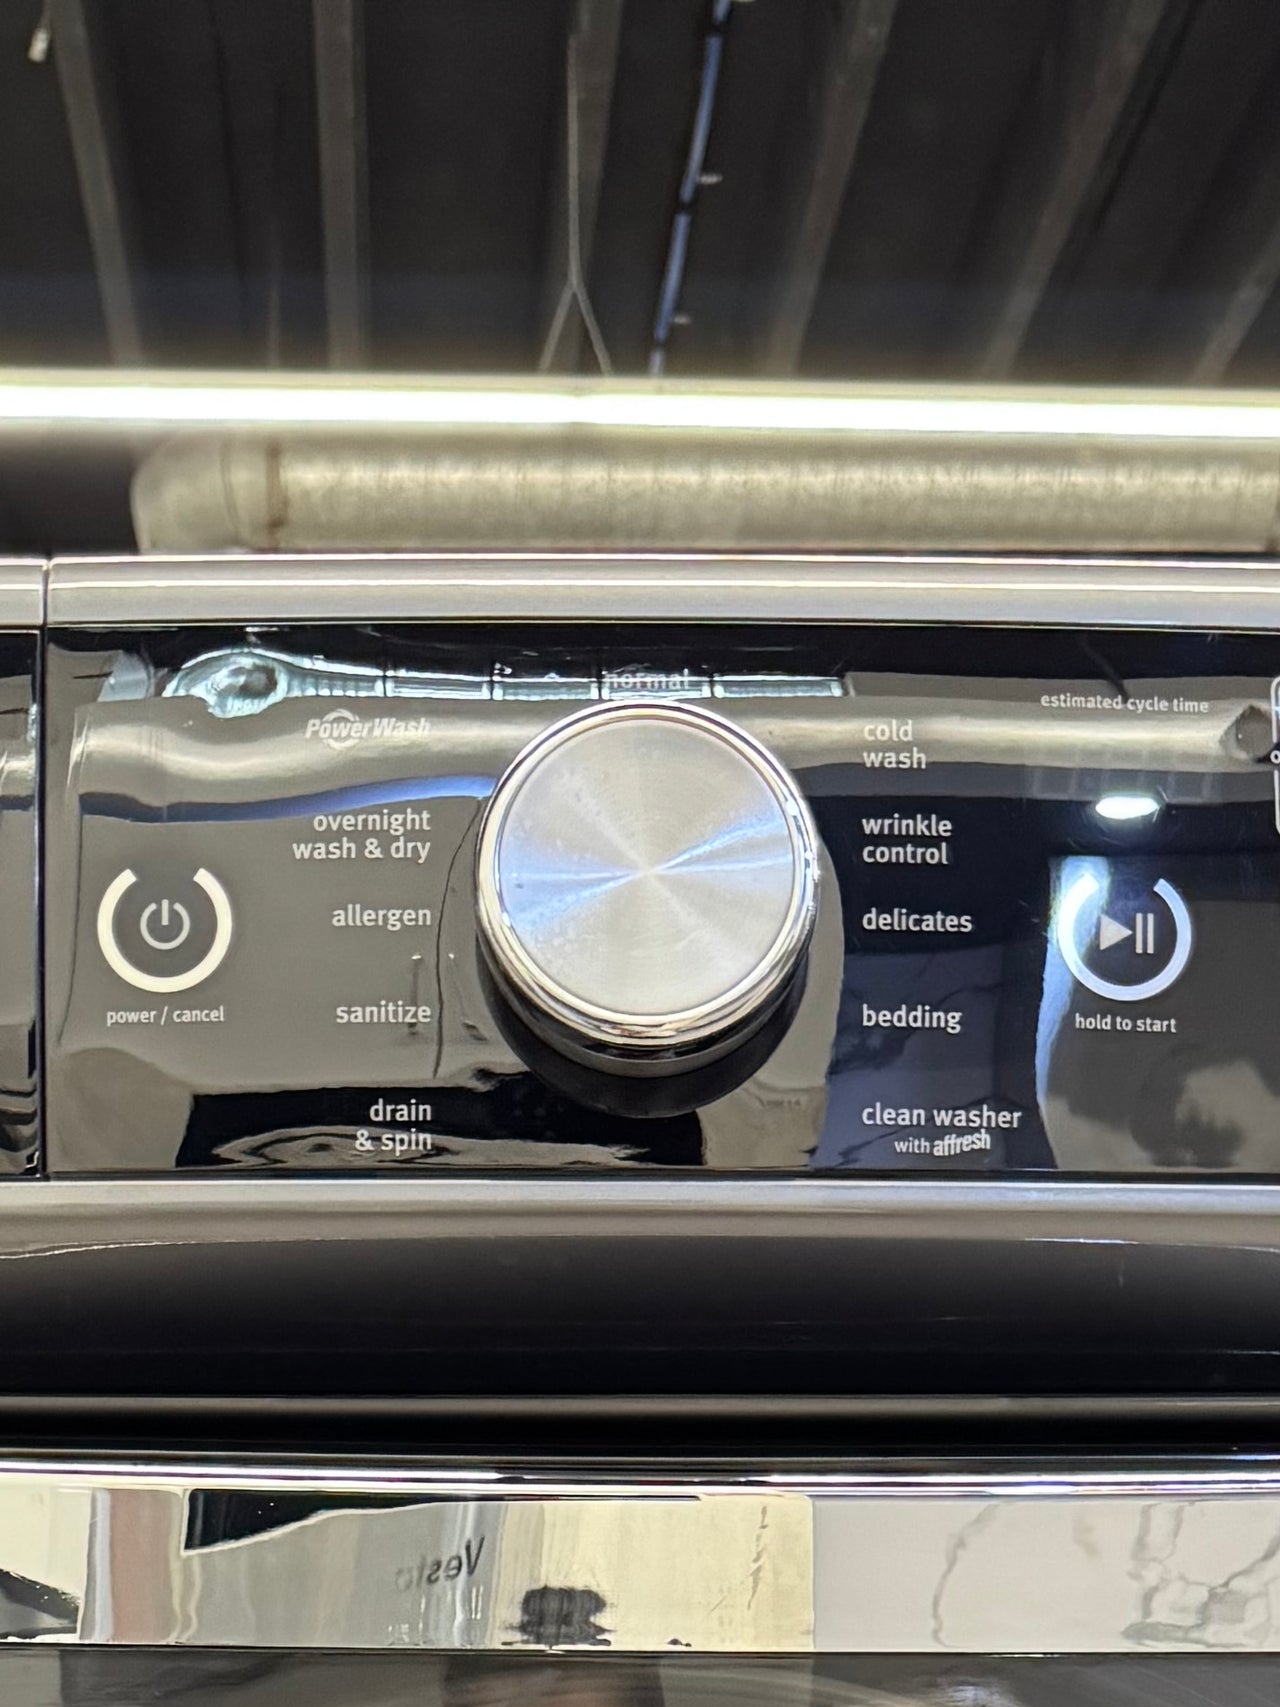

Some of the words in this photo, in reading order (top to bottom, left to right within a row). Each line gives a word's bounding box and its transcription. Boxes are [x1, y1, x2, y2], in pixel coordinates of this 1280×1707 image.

[1039, 692, 1123, 711] estimated
[1125, 696, 1170, 714] cycle
[1171, 696, 1210, 714] time
[305, 715, 432, 741] PowerWash
[862, 719, 914, 743] cold
[862, 747, 928, 771] wash
[312, 809, 431, 837] overnight
[861, 814, 953, 839] wrinkle
[292, 838, 357, 859] wash
[363, 838, 385, 860] &
[389, 837, 431, 864] dry
[862, 842, 950, 866] control
[331, 904, 432, 932] allergen
[861, 908, 974, 934] delicates
[106, 1007, 157, 1028] power
[172, 1004, 225, 1024] cancel
[335, 1001, 432, 1025] sanitize
[861, 1004, 964, 1035] bedding
[1074, 1013, 1113, 1033] hold
[1115, 1015, 1132, 1033] to
[1134, 1014, 1178, 1034] start
[368, 1099, 433, 1123] drain
[861, 1103, 927, 1128] clean
[931, 1105, 1023, 1130] washer
[354, 1129, 375, 1152] &
[380, 1129, 433, 1156] spin
[893, 1135, 931, 1155] with
[931, 1130, 992, 1158] affresh
